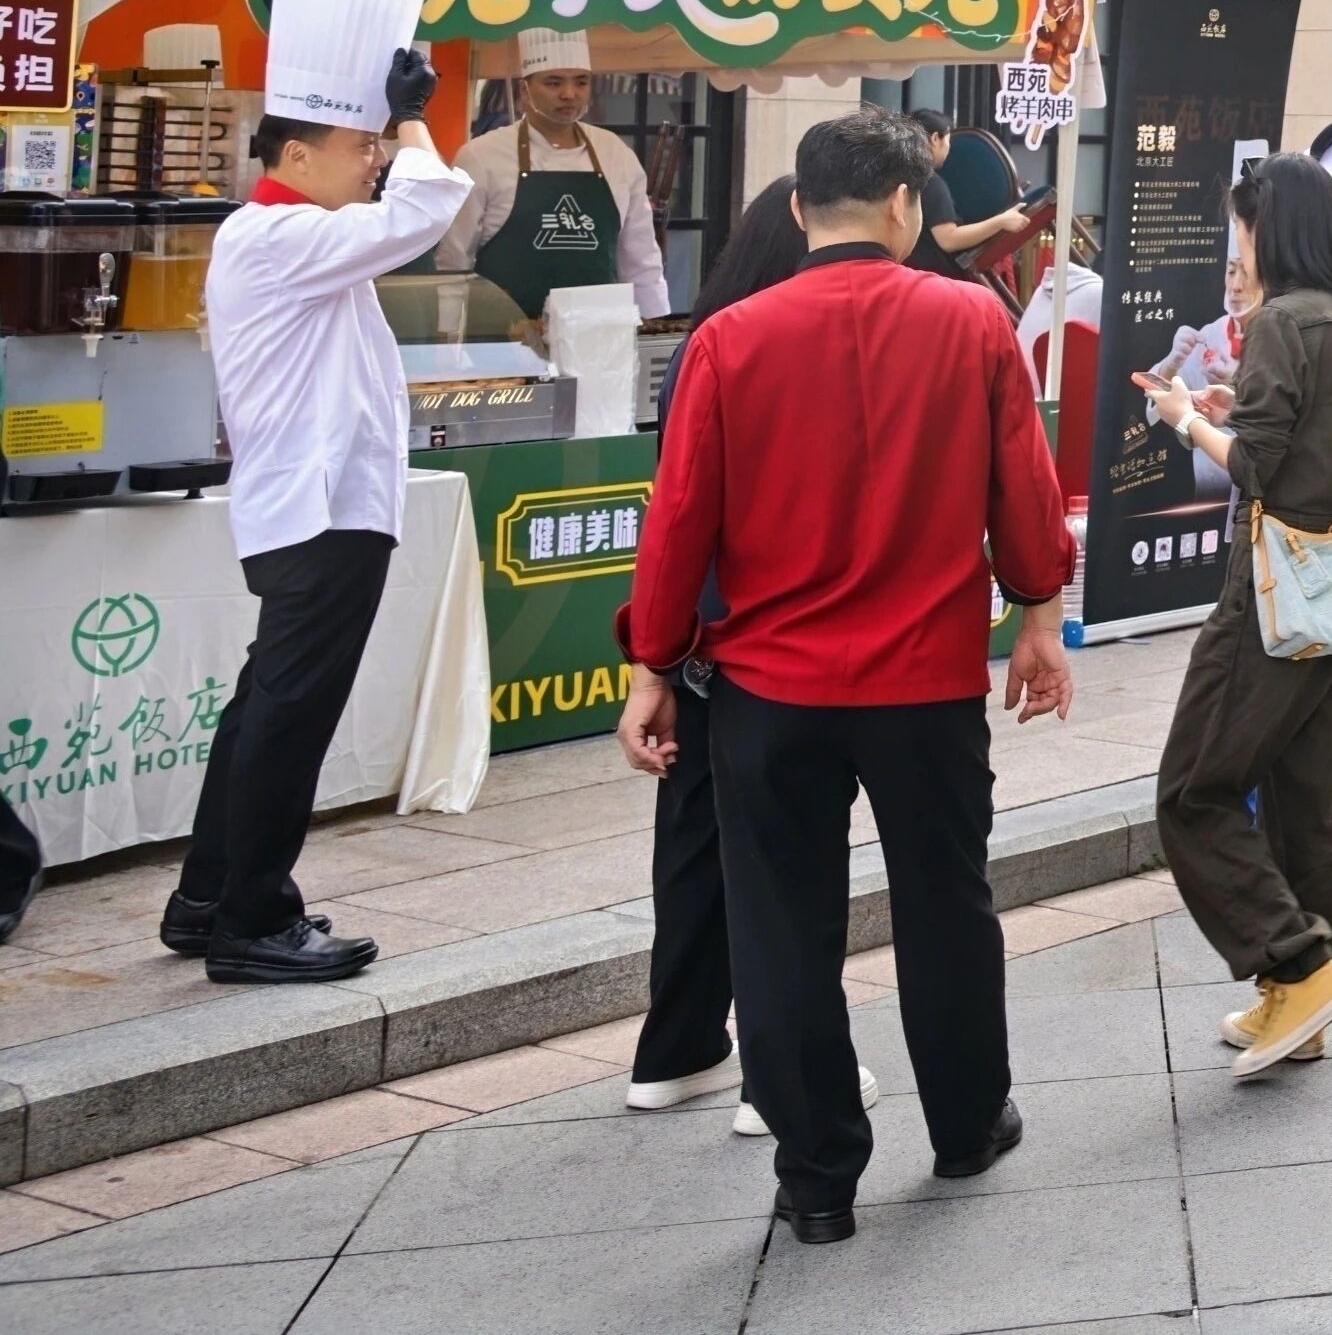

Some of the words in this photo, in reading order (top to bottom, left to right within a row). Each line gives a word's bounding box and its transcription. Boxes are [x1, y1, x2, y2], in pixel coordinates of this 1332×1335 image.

[0, 54, 54, 92] 担
[1007, 67, 1049, 94] 西苑
[1000, 94, 1074, 122] 烤羊肉串
[1136, 124, 1176, 152] 范毅
[1135, 156, 1174, 167] 北京大工匠
[1121, 290, 1164, 305] 传承经典
[1134, 309, 1175, 323] 匠心之作
[413, 392, 448, 411] HOT
[450, 389, 484, 409] DOG
[487, 386, 535, 406] GRILL
[529, 507, 638, 560] 健康美味
[134, 741, 211, 776] HOTE
